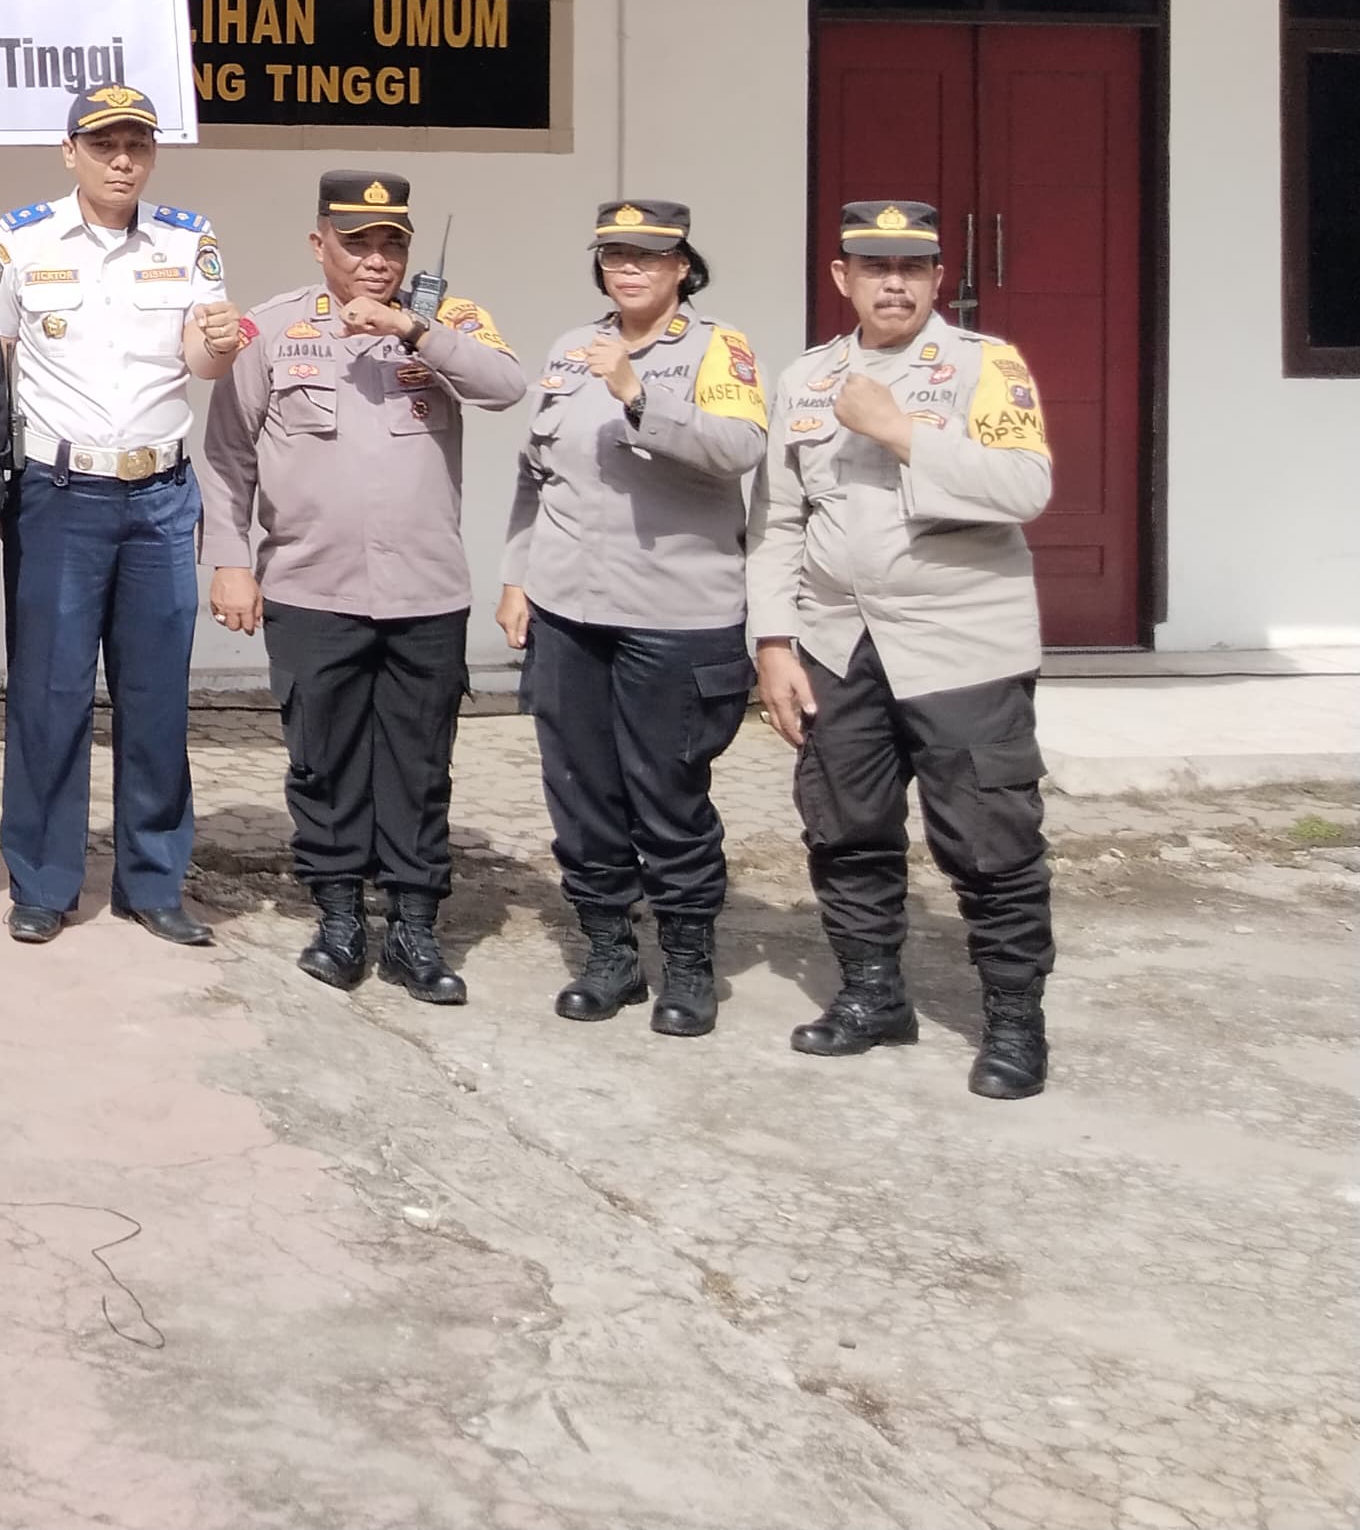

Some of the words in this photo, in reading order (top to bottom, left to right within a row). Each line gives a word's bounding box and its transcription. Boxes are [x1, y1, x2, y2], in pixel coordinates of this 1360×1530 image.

[0, 37, 126, 94] Tinggi
[265, 64, 421, 106] TINGGI
[699, 384, 742, 406] KASET
[980, 425, 1025, 447] OPS
